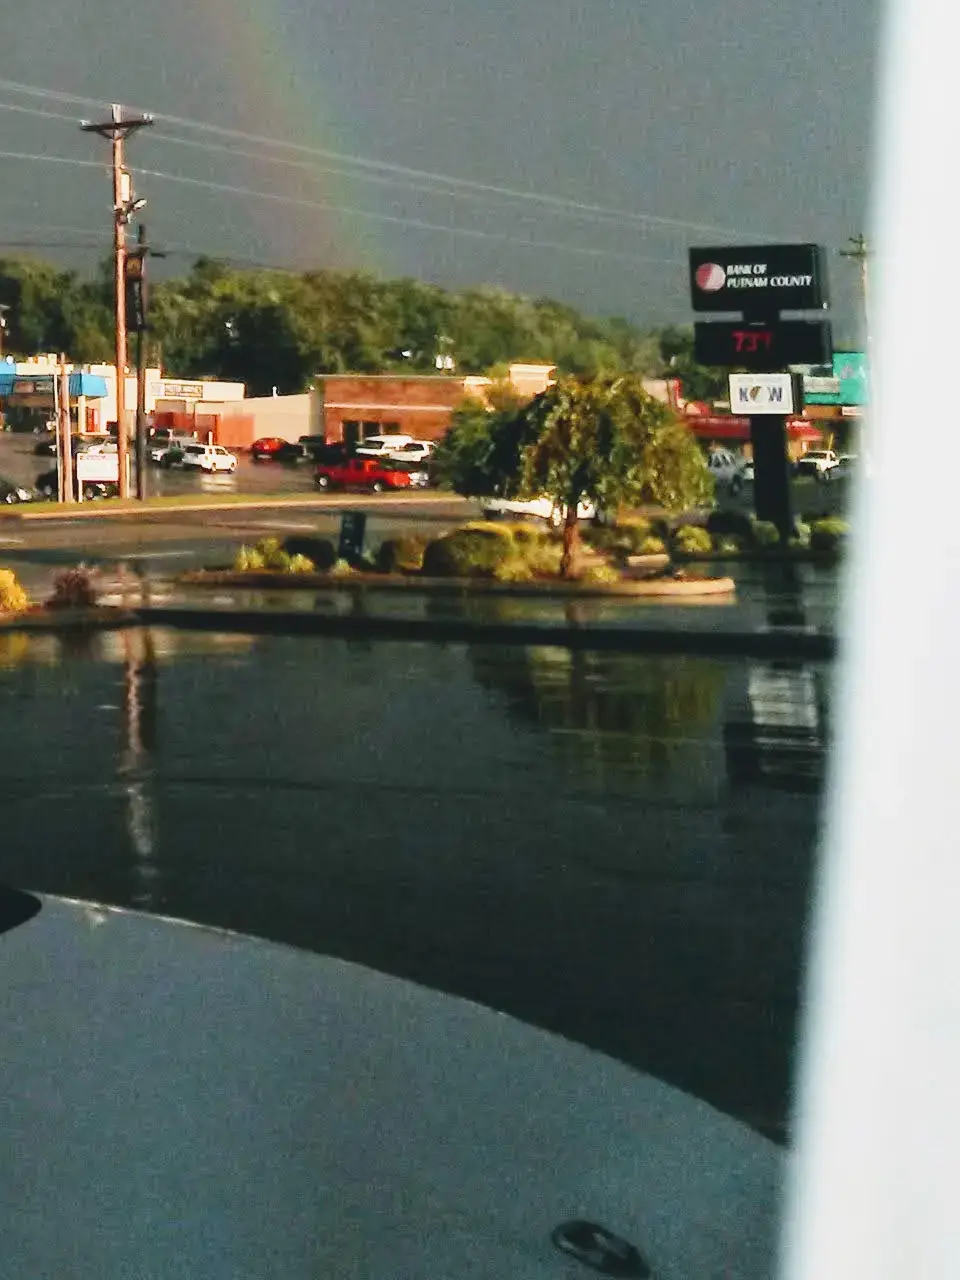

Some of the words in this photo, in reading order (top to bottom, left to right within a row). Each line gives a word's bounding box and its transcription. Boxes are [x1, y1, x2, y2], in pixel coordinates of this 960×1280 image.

[726, 264, 752, 275] BANK
[753, 264, 767, 274] OF
[726, 277, 768, 288] PUTNAM
[770, 275, 812, 287] COUNTY
